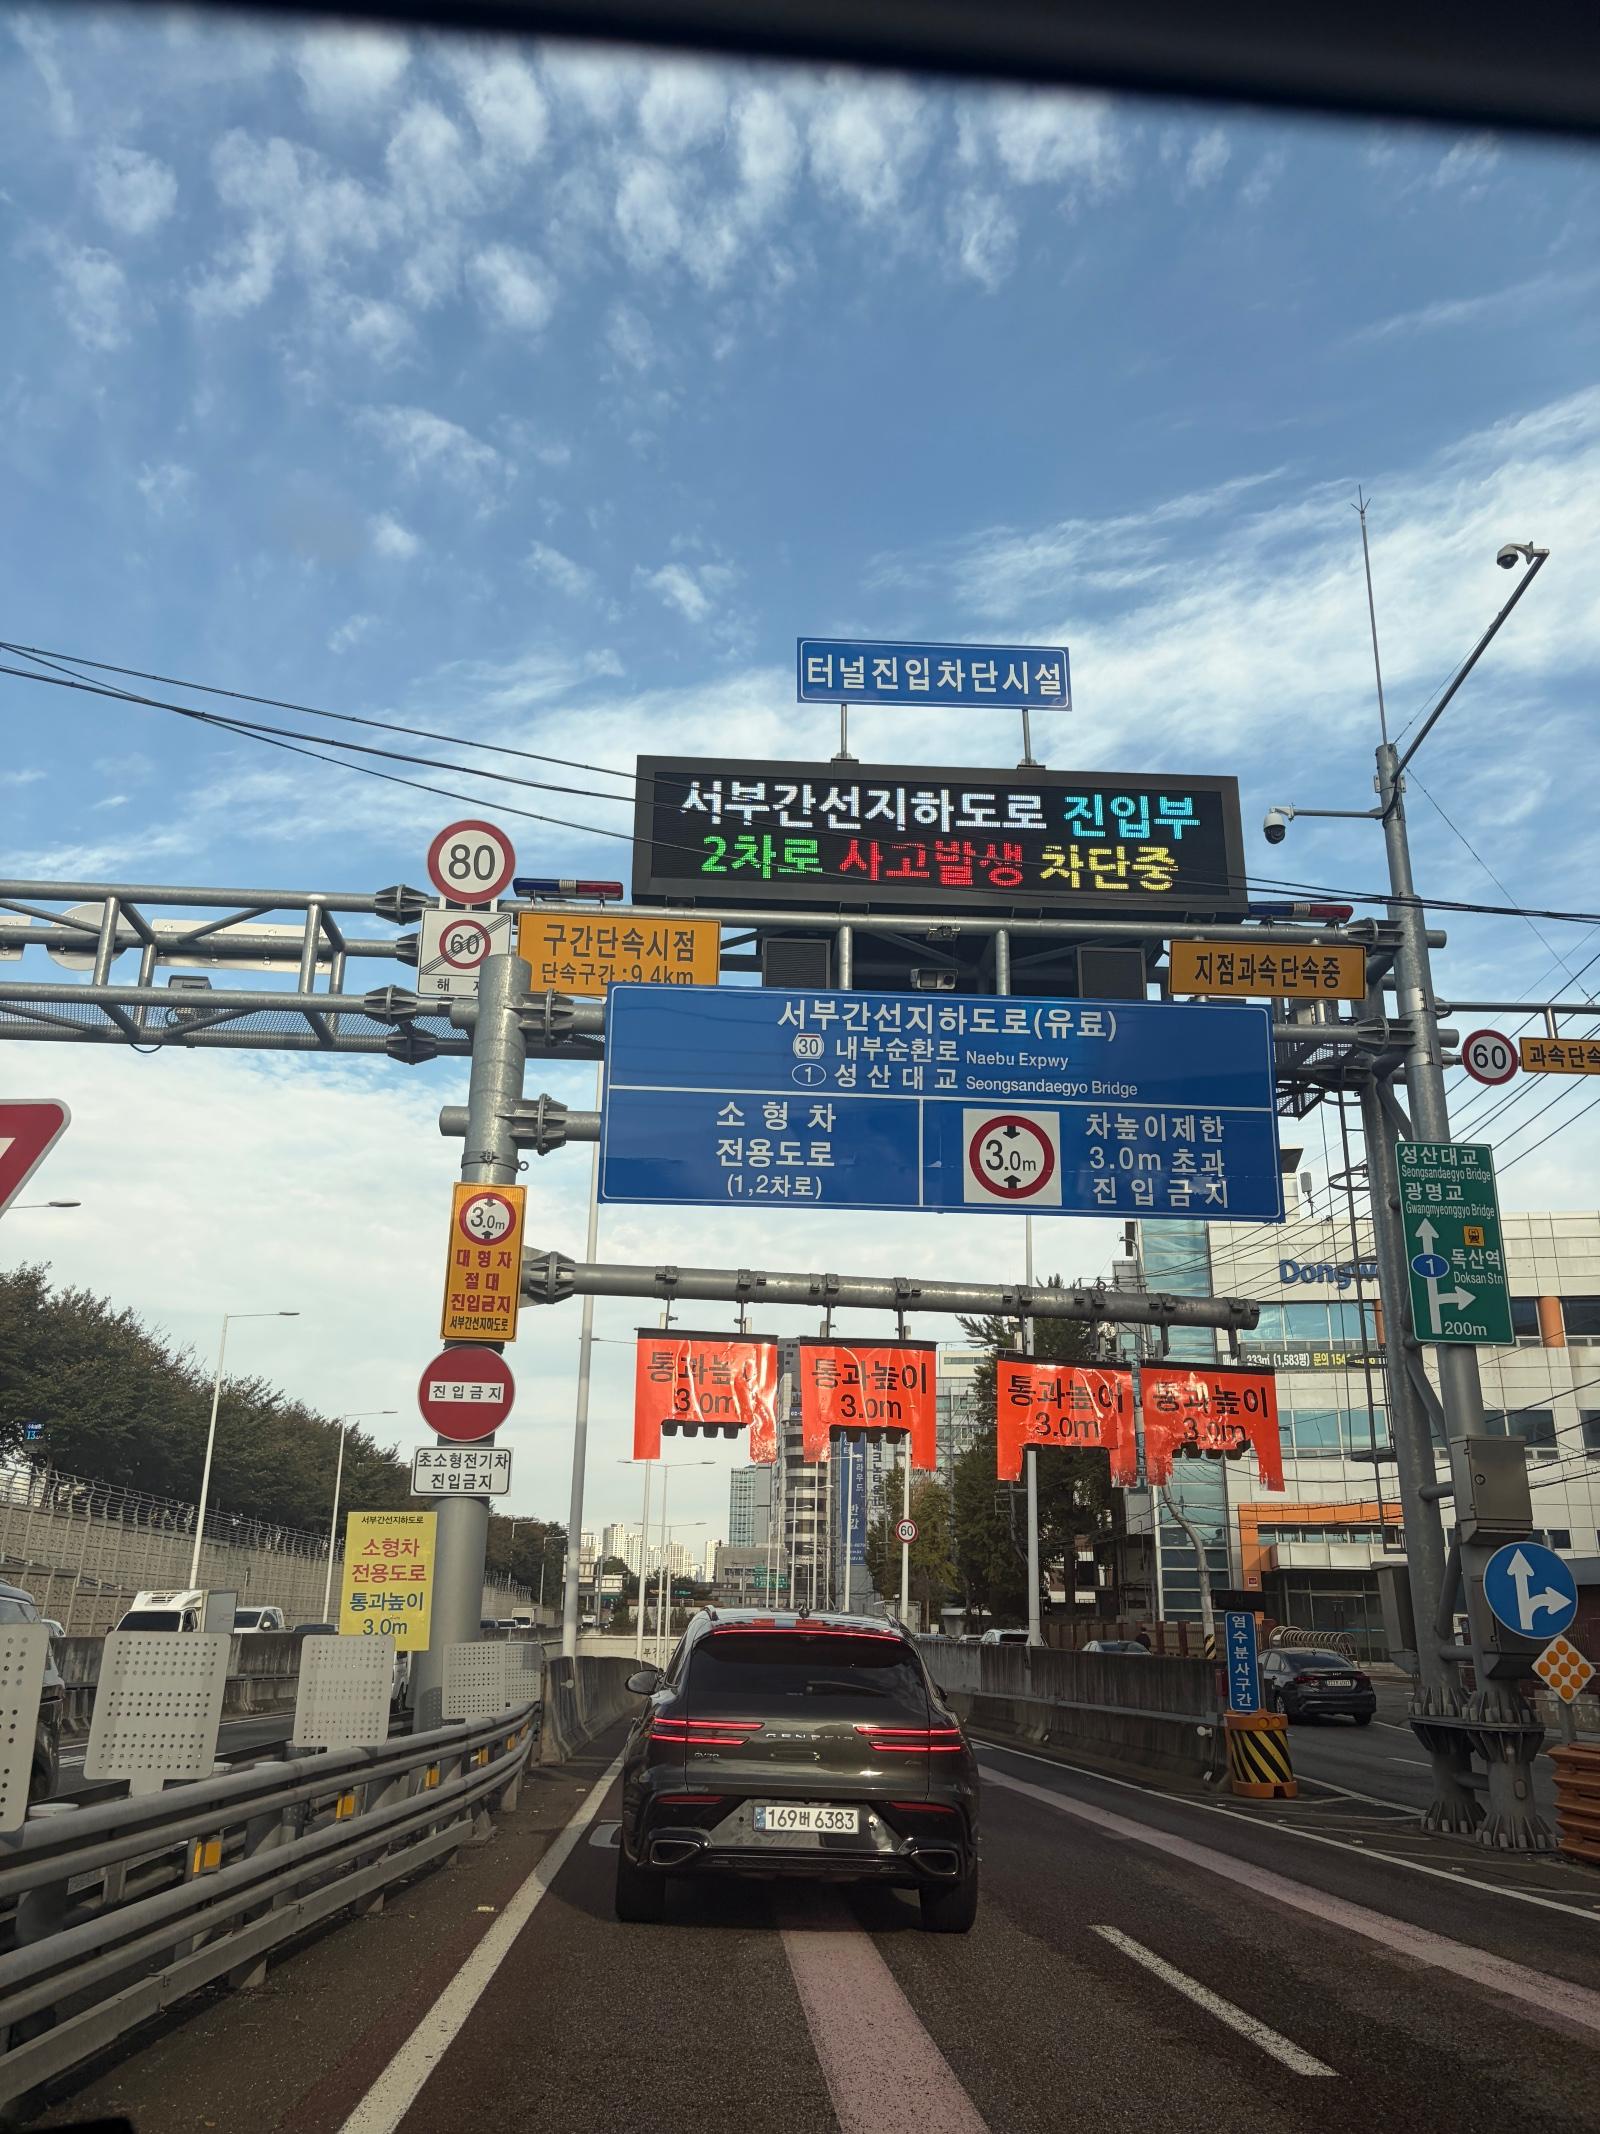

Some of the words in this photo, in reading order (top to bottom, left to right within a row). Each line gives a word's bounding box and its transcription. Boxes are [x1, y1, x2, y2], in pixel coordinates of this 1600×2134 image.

[807, 653, 1063, 697] 터널진입차단시설
[681, 780, 1047, 833] 서부간선지하도로
[1063, 793, 1200, 840] 진입부
[448, 843, 496, 881] 80
[701, 834, 823, 879] 2차로
[839, 839, 1024, 886] 사고발생
[1040, 844, 1179, 890] 차단중
[450, 933, 480, 956] 60
[543, 922, 695, 963] 구간단속시점
[1195, 951, 1341, 989] 지점과속단속중
[777, 1000, 1117, 1042] 서부간선지하도로(유료)
[797, 1037, 820, 1056] 30
[836, 1036, 960, 1064] 내부순환로
[966, 1050, 1015, 1067] Naebu
[1019, 1051, 1069, 1071] Expwy
[1472, 1043, 1507, 1070] 60
[834, 1063, 959, 1091] 성산대교
[966, 1075, 1088, 1096] Seongsandaegyo
[1091, 1080, 1138, 1097] Bridge
[1085, 1112, 1224, 1143] 차높이제한
[716, 1137, 836, 1169] 전용도로
[985, 1139, 1037, 1173] 3.0m
[1089, 1145, 1162, 1172] 3.0m
[1172, 1147, 1224, 1178] 초과
[1400, 1145, 1479, 1167] 성산대교
[726, 1174, 823, 1200] (1,2차로)
[1401, 1165, 1465, 1183] Seongsandaegyo
[1466, 1168, 1491, 1183] Bridge
[1092, 1177, 1229, 1209] 진입금지
[1405, 1182, 1464, 1202] 광명교
[470, 1206, 505, 1230] 3.0m
[1405, 1201, 1471, 1219] Gwangmyeonggyo
[1471, 1203, 1495, 1220] Bridge
[1425, 1258, 1434, 1275] 1
[1451, 1248, 1501, 1271] 독산역
[1453, 1271, 1487, 1284] Doksan
[1487, 1273, 1503, 1285] Stn
[451, 1293, 511, 1314] 진입금지
[450, 1315, 509, 1332] 서부간선지하도로
[1444, 1321, 1488, 1336] 200m
[811, 1358, 927, 1394] 통과높이
[432, 1384, 502, 1401] 진입금지
[675, 1388, 734, 1414] 30m
[1008, 1374, 1123, 1414] 통과높이
[1153, 1381, 1269, 1418] 통과높이
[840, 1394, 902, 1420] 3.0m
[1035, 1411, 1099, 1438] 3.0m
[1183, 1417, 1246, 1441] 3.0m
[417, 1452, 509, 1471] 초소형전기차
[430, 1472, 493, 1491] 진입금지
[361, 1515, 424, 1525] 서부간선지하도로
[900, 1525, 914, 1537] 60
[361, 1538, 420, 1558] 소형차
[351, 1562, 427, 1584] 전용도로
[349, 1591, 424, 1612] 통과높이
[362, 1618, 408, 1636] 3.0m
[1231, 1615, 1252, 1707] 염수분사구간
[814, 1811, 855, 1831] 6383
